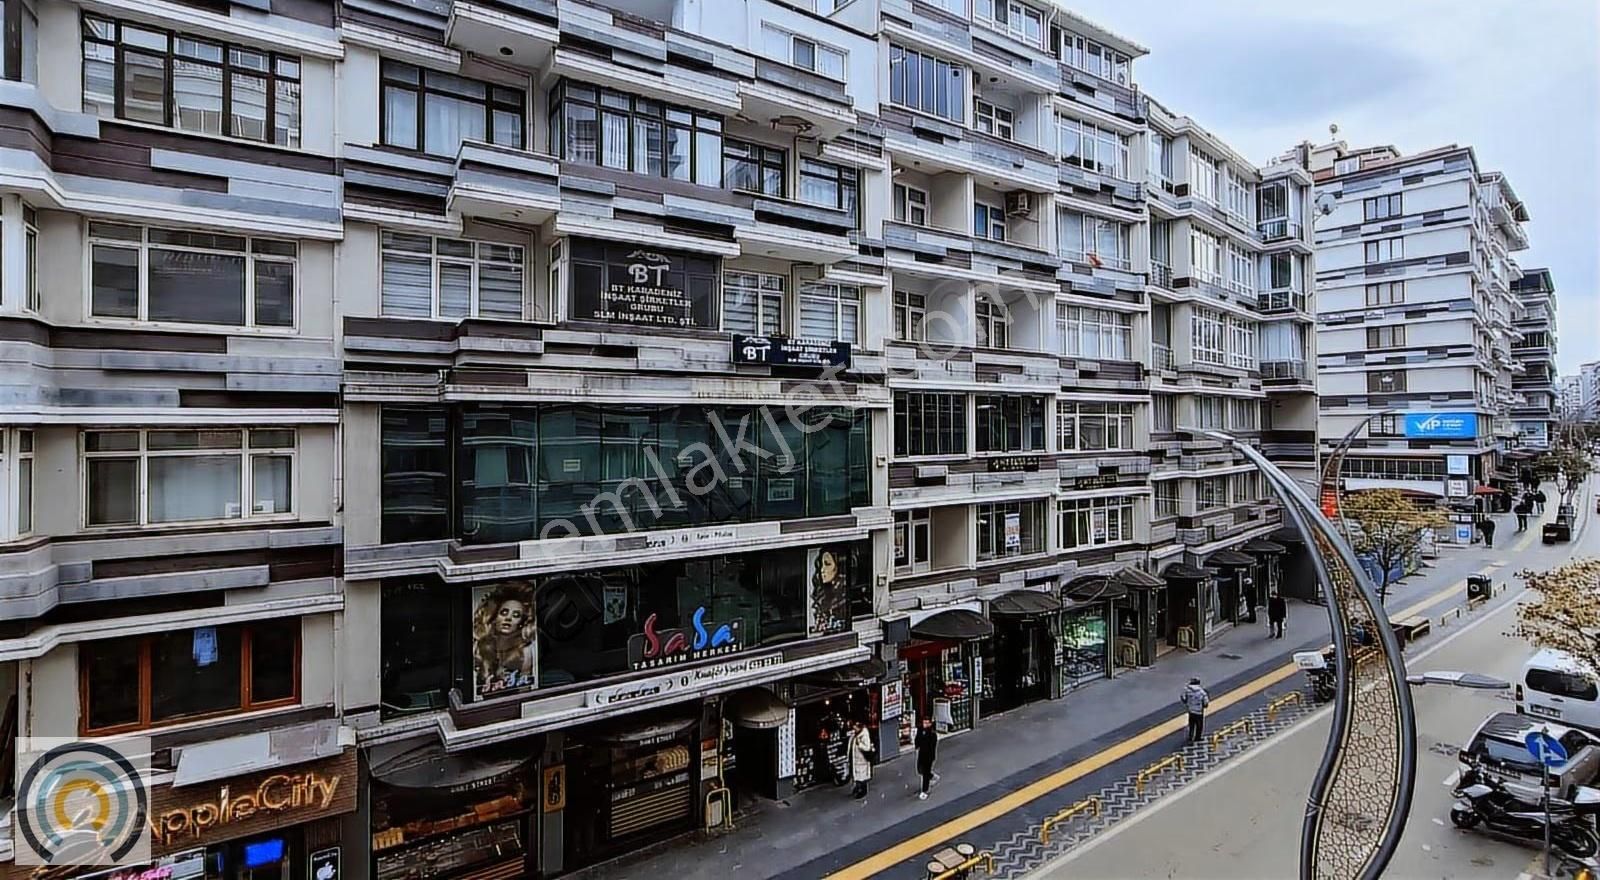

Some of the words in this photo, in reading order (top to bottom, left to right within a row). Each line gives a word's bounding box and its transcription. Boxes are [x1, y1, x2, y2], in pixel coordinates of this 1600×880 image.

[628, 263, 670, 287] BT
[742, 345, 771, 361] BT
[633, 653, 687, 671] TASARIM
